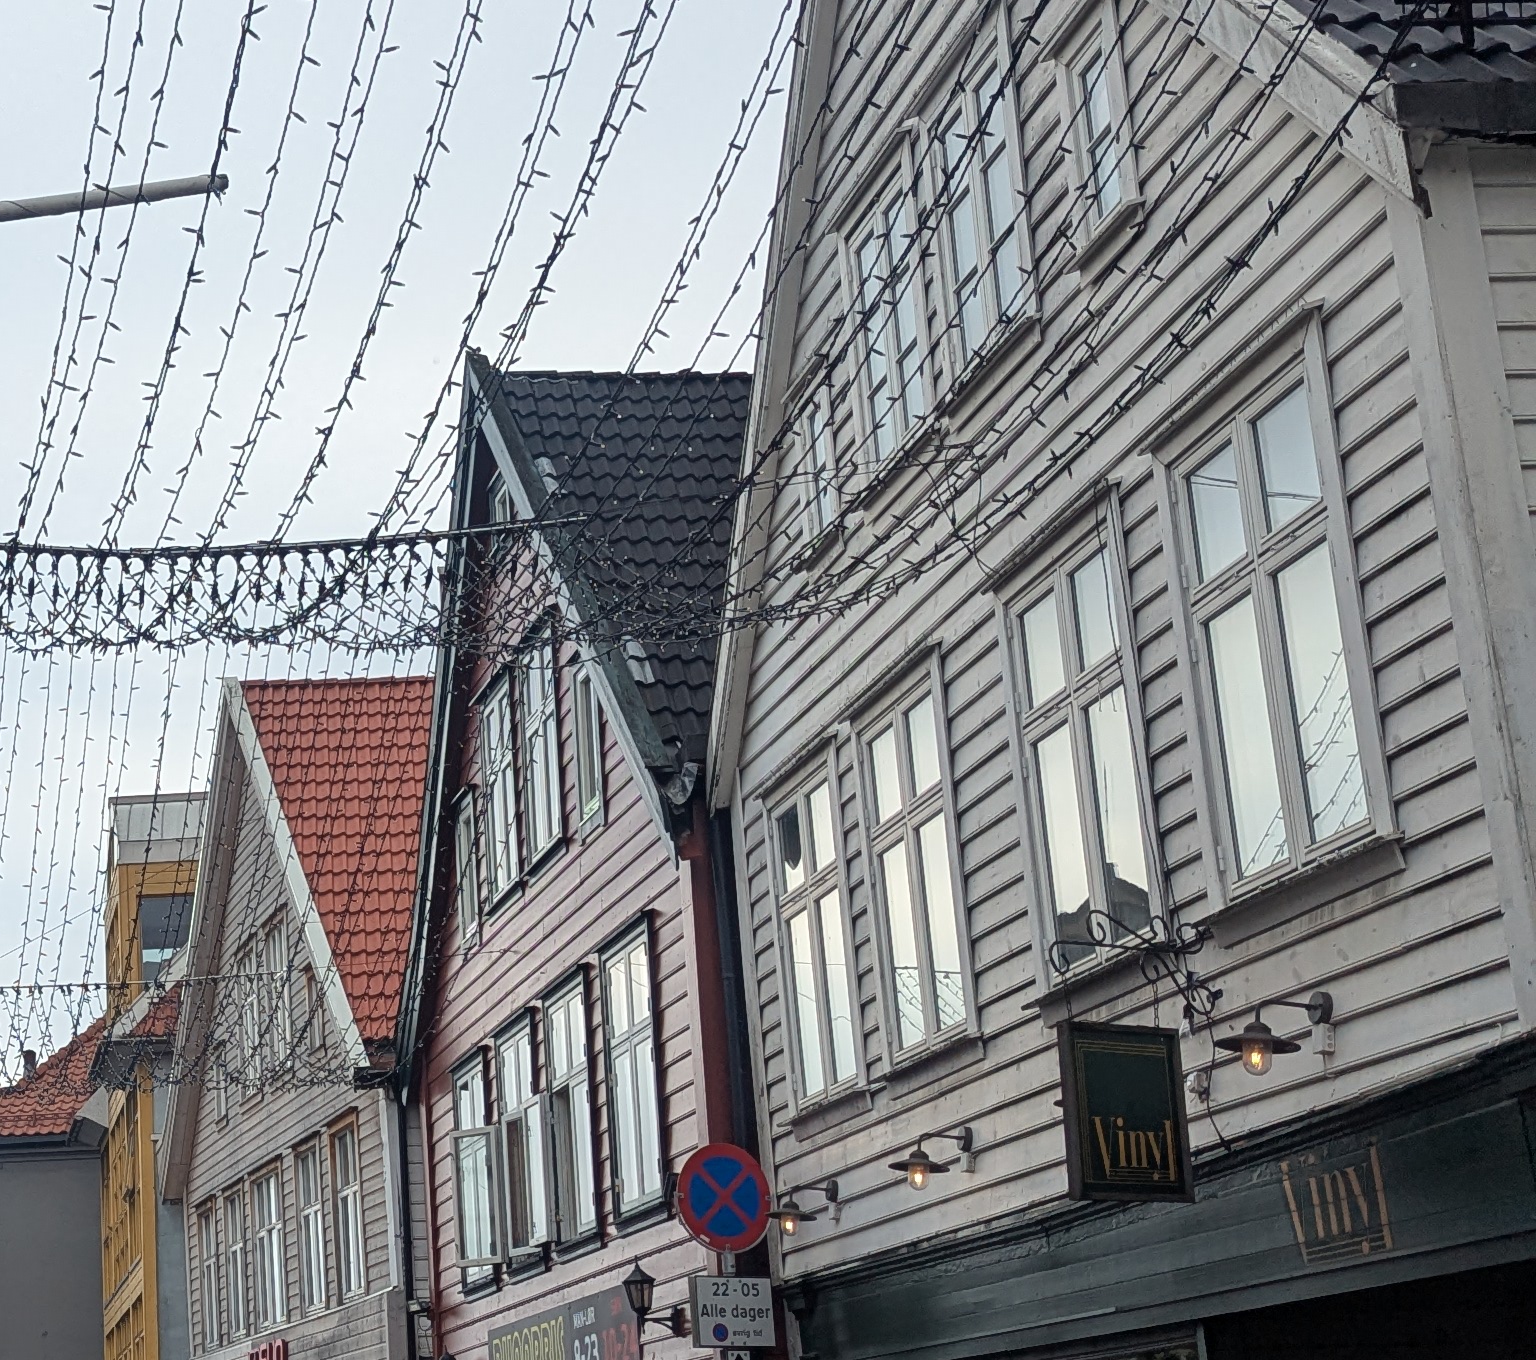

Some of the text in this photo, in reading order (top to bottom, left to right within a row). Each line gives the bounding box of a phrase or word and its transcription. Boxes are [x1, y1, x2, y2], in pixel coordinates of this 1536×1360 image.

[1091, 1116, 1179, 1182] Vinyl
[1280, 1138, 1393, 1266] Vinyl
[701, 1304, 771, 1322] Alle dager
